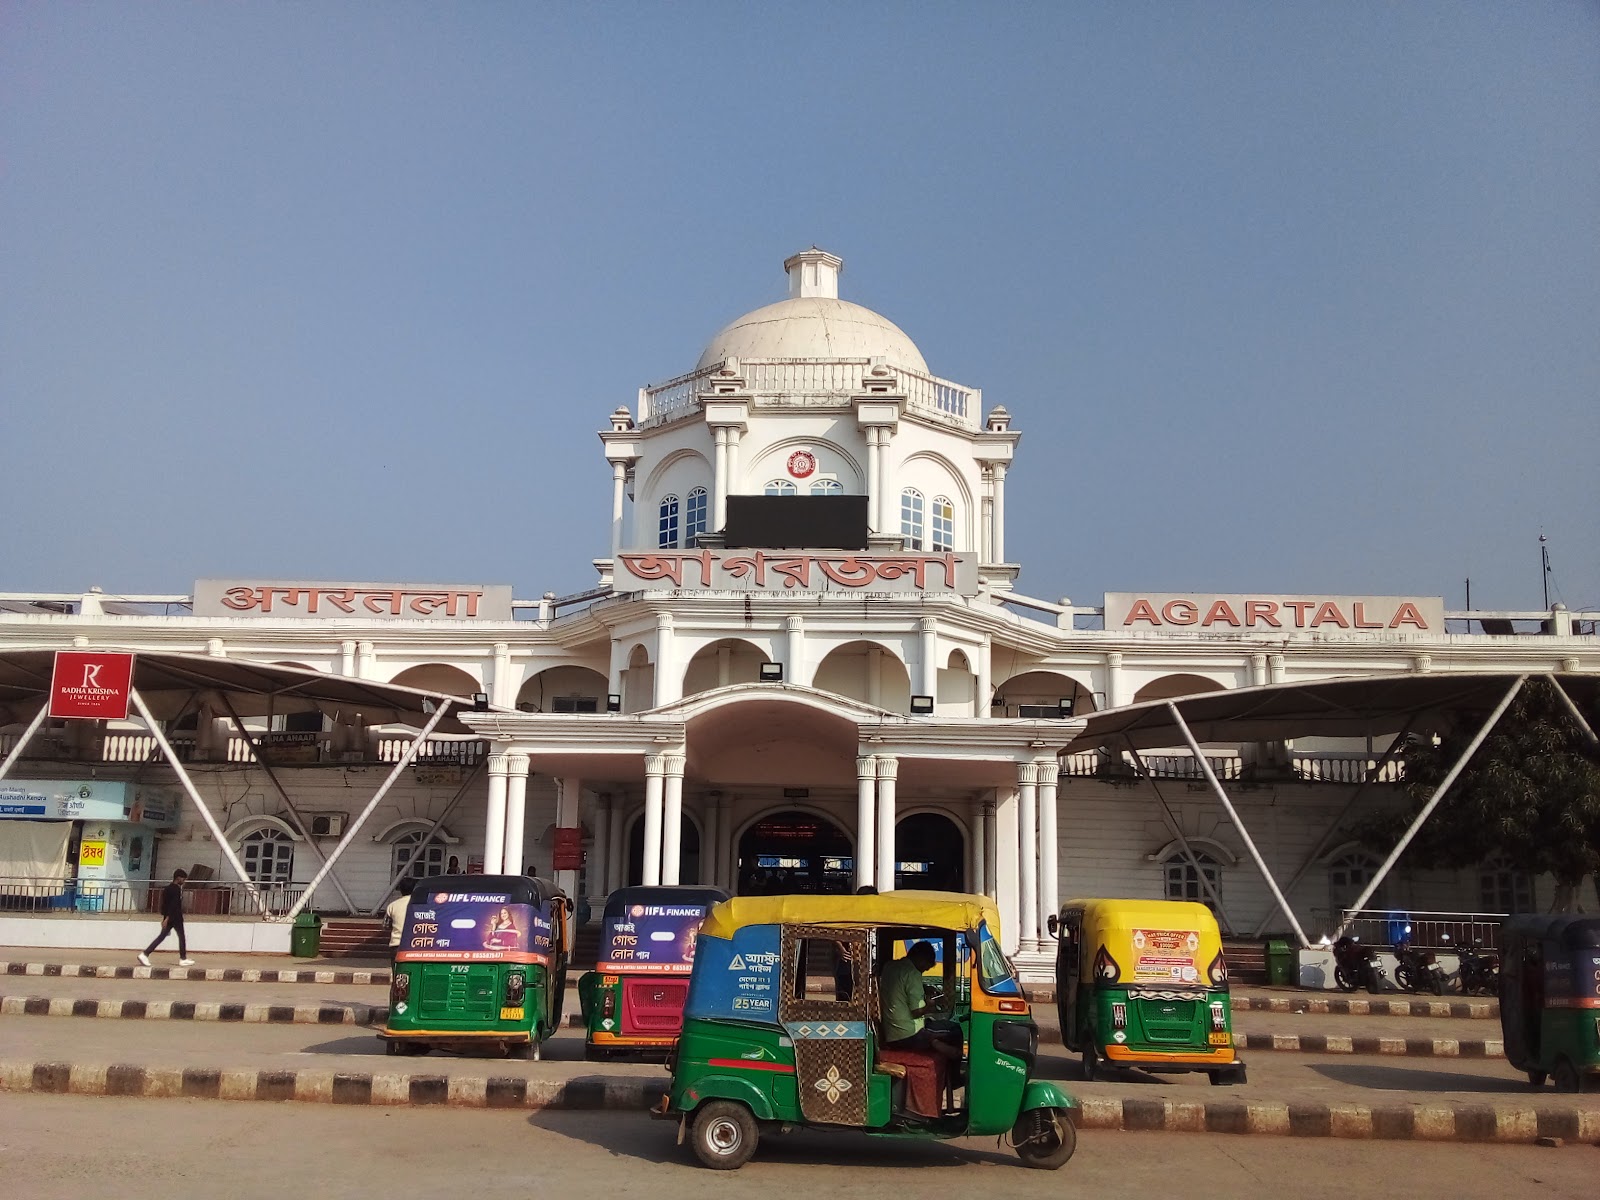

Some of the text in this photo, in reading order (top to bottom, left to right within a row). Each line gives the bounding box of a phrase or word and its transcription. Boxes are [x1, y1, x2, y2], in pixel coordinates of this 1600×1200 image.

[617, 550, 964, 590] আগরতলা
[220, 585, 484, 617] अगरतला
[1122, 598, 1430, 630] AGARTALA
[61, 686, 119, 695] RADHA KRISHNA
[286, 734, 315, 742] AHAAR
[448, 893, 506, 903] IIFL FINANCE
[644, 906, 701, 916] IIFL FINANCE
[412, 922, 439, 935] গোল্ড
[410, 937, 435, 948] লোন
[612, 934, 639, 946] গোল্ড
[610, 948, 635, 960] লোন
[450, 965, 470, 973] TVS
[734, 998, 770, 1009] 25 YEAR
